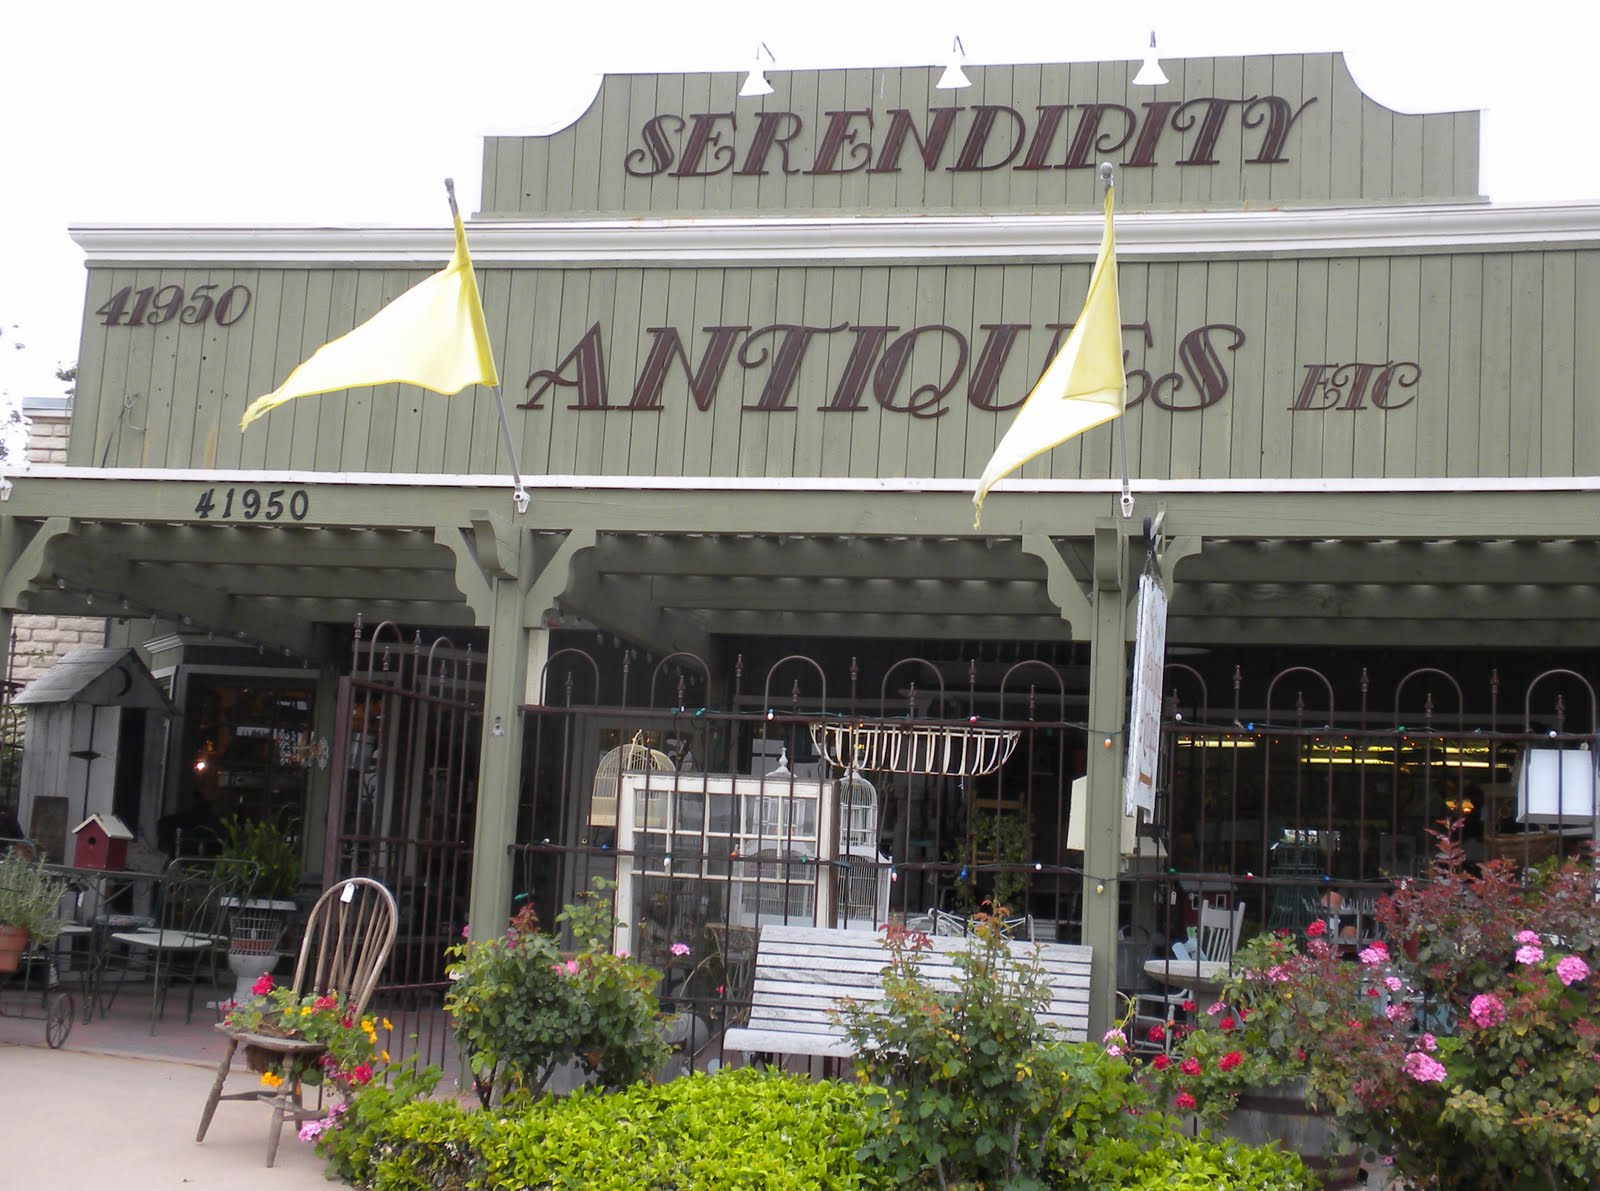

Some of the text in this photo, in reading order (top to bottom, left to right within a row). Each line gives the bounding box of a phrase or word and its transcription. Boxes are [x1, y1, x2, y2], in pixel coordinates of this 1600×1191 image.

[625, 96, 1318, 177] SERENDIPITY
[95, 284, 252, 326] 41950
[1287, 361, 1421, 410] ETC
[195, 488, 309, 520] 41950
